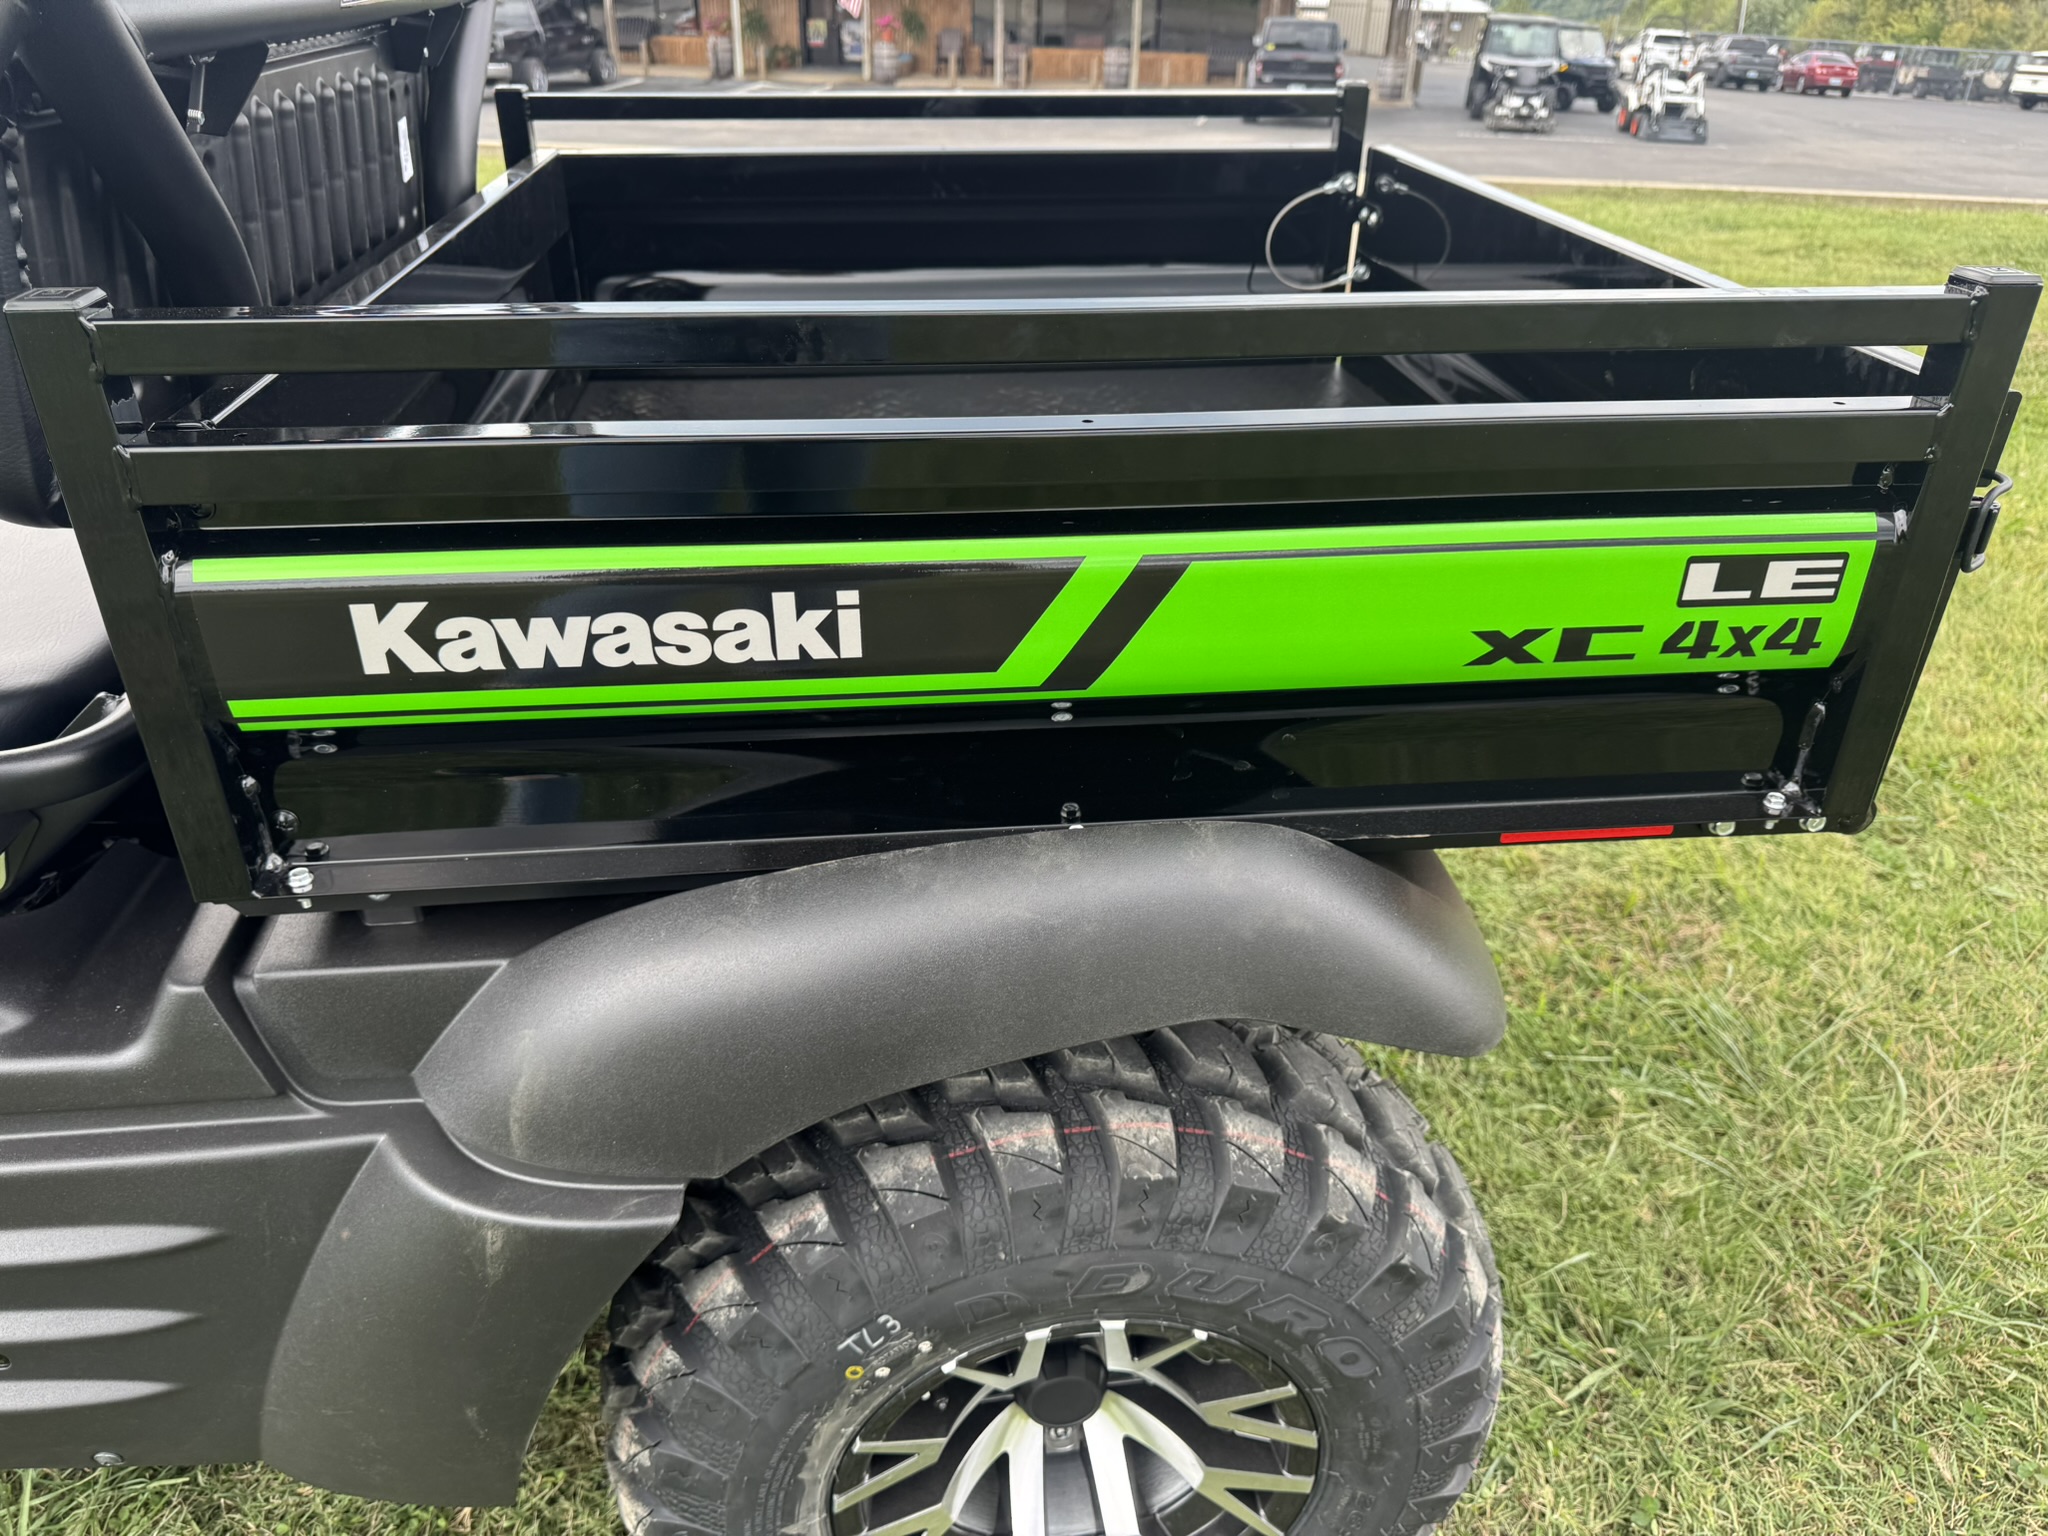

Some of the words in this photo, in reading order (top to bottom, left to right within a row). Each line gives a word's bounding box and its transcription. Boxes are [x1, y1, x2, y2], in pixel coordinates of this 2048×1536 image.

[1681, 559, 1845, 602] LE
[349, 589, 863, 675] Kawasaki
[1463, 624, 1645, 667] XC
[1658, 616, 1823, 660] 4x4
[836, 1313, 902, 1356] TL3
[1067, 1263, 1382, 1378] DURO
